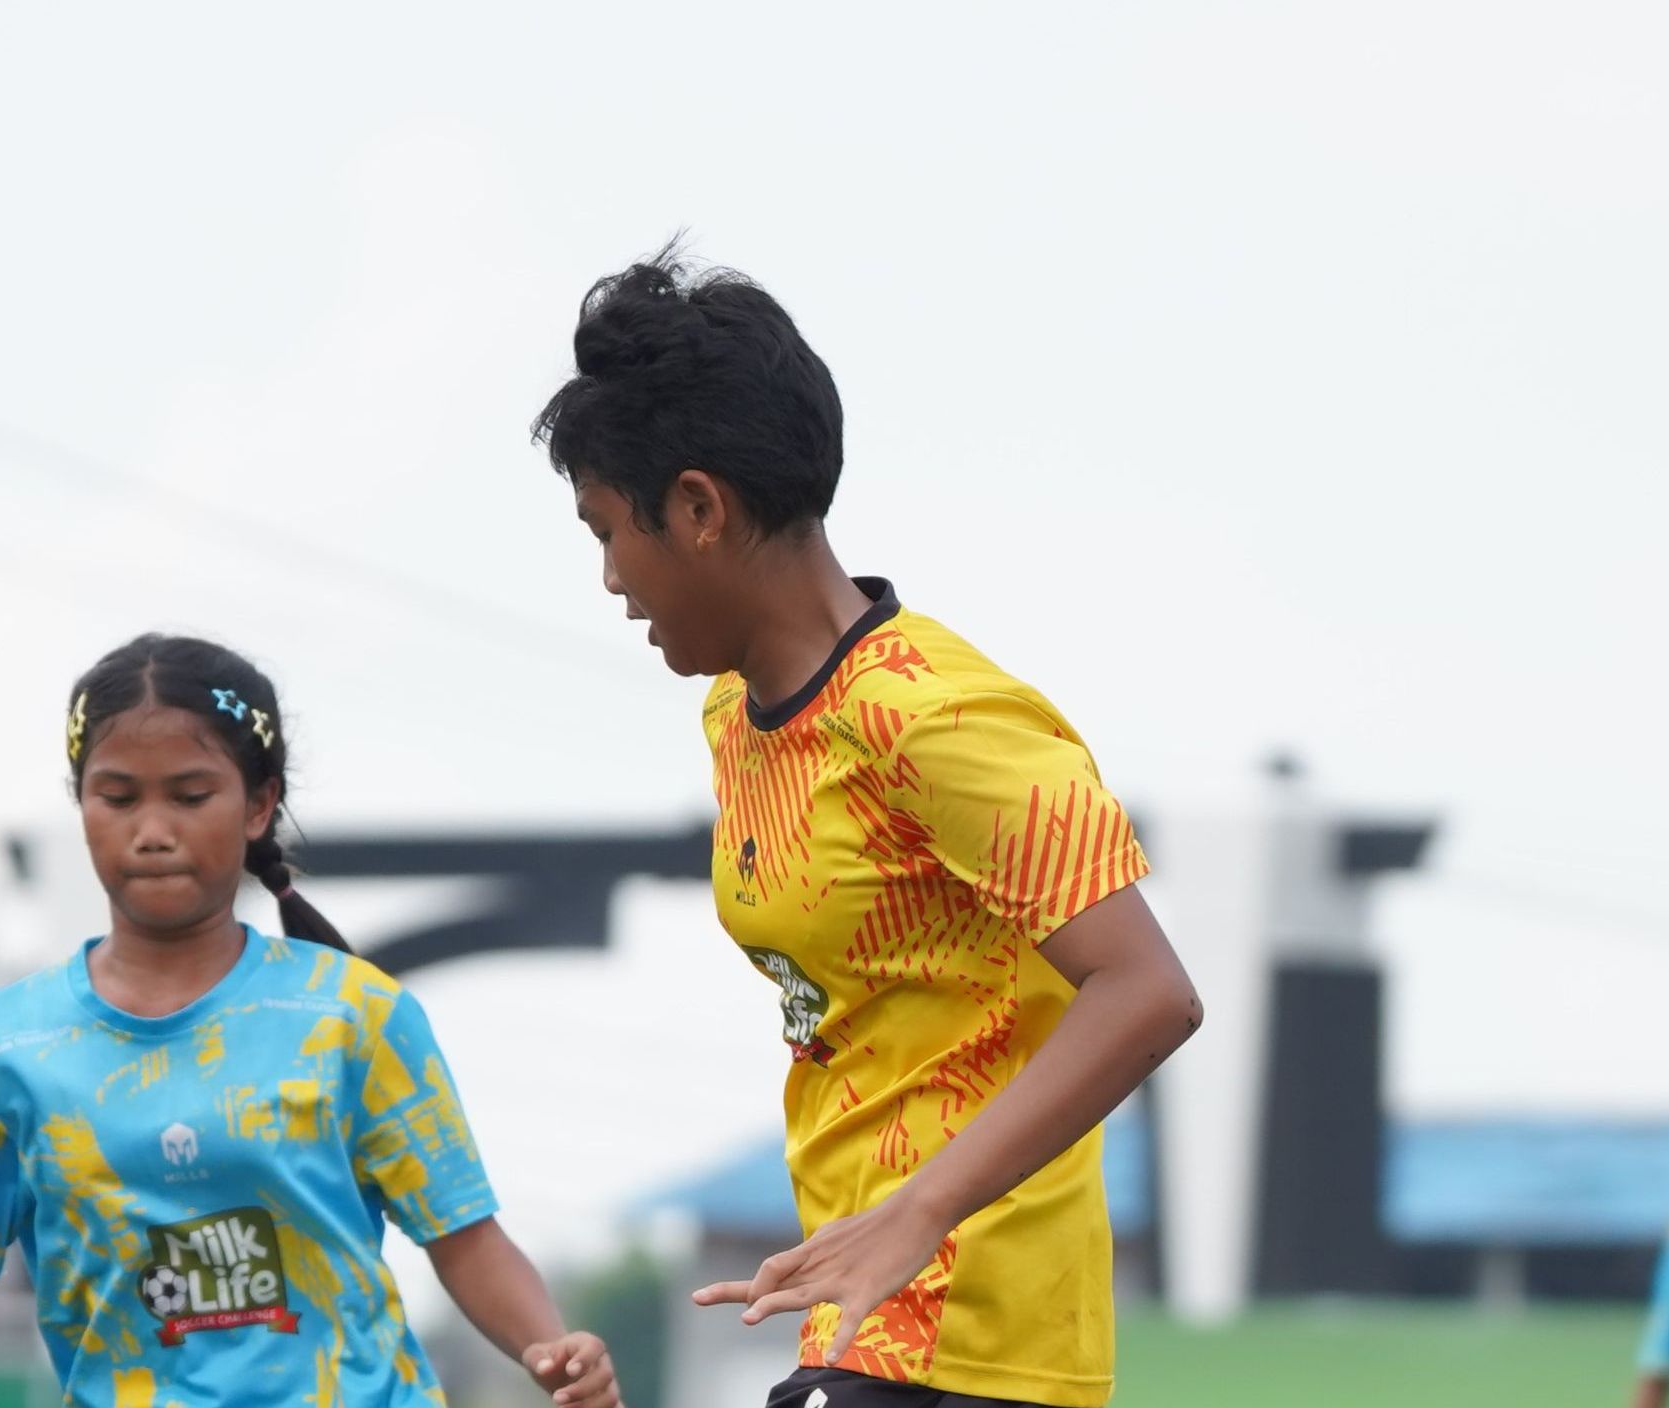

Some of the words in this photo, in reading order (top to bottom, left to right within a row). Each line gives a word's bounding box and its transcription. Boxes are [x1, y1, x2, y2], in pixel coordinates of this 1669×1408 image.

[164, 1169, 210, 1184] MILLS
[164, 1216, 268, 1267] Milk
[187, 1262, 278, 1312] Life
